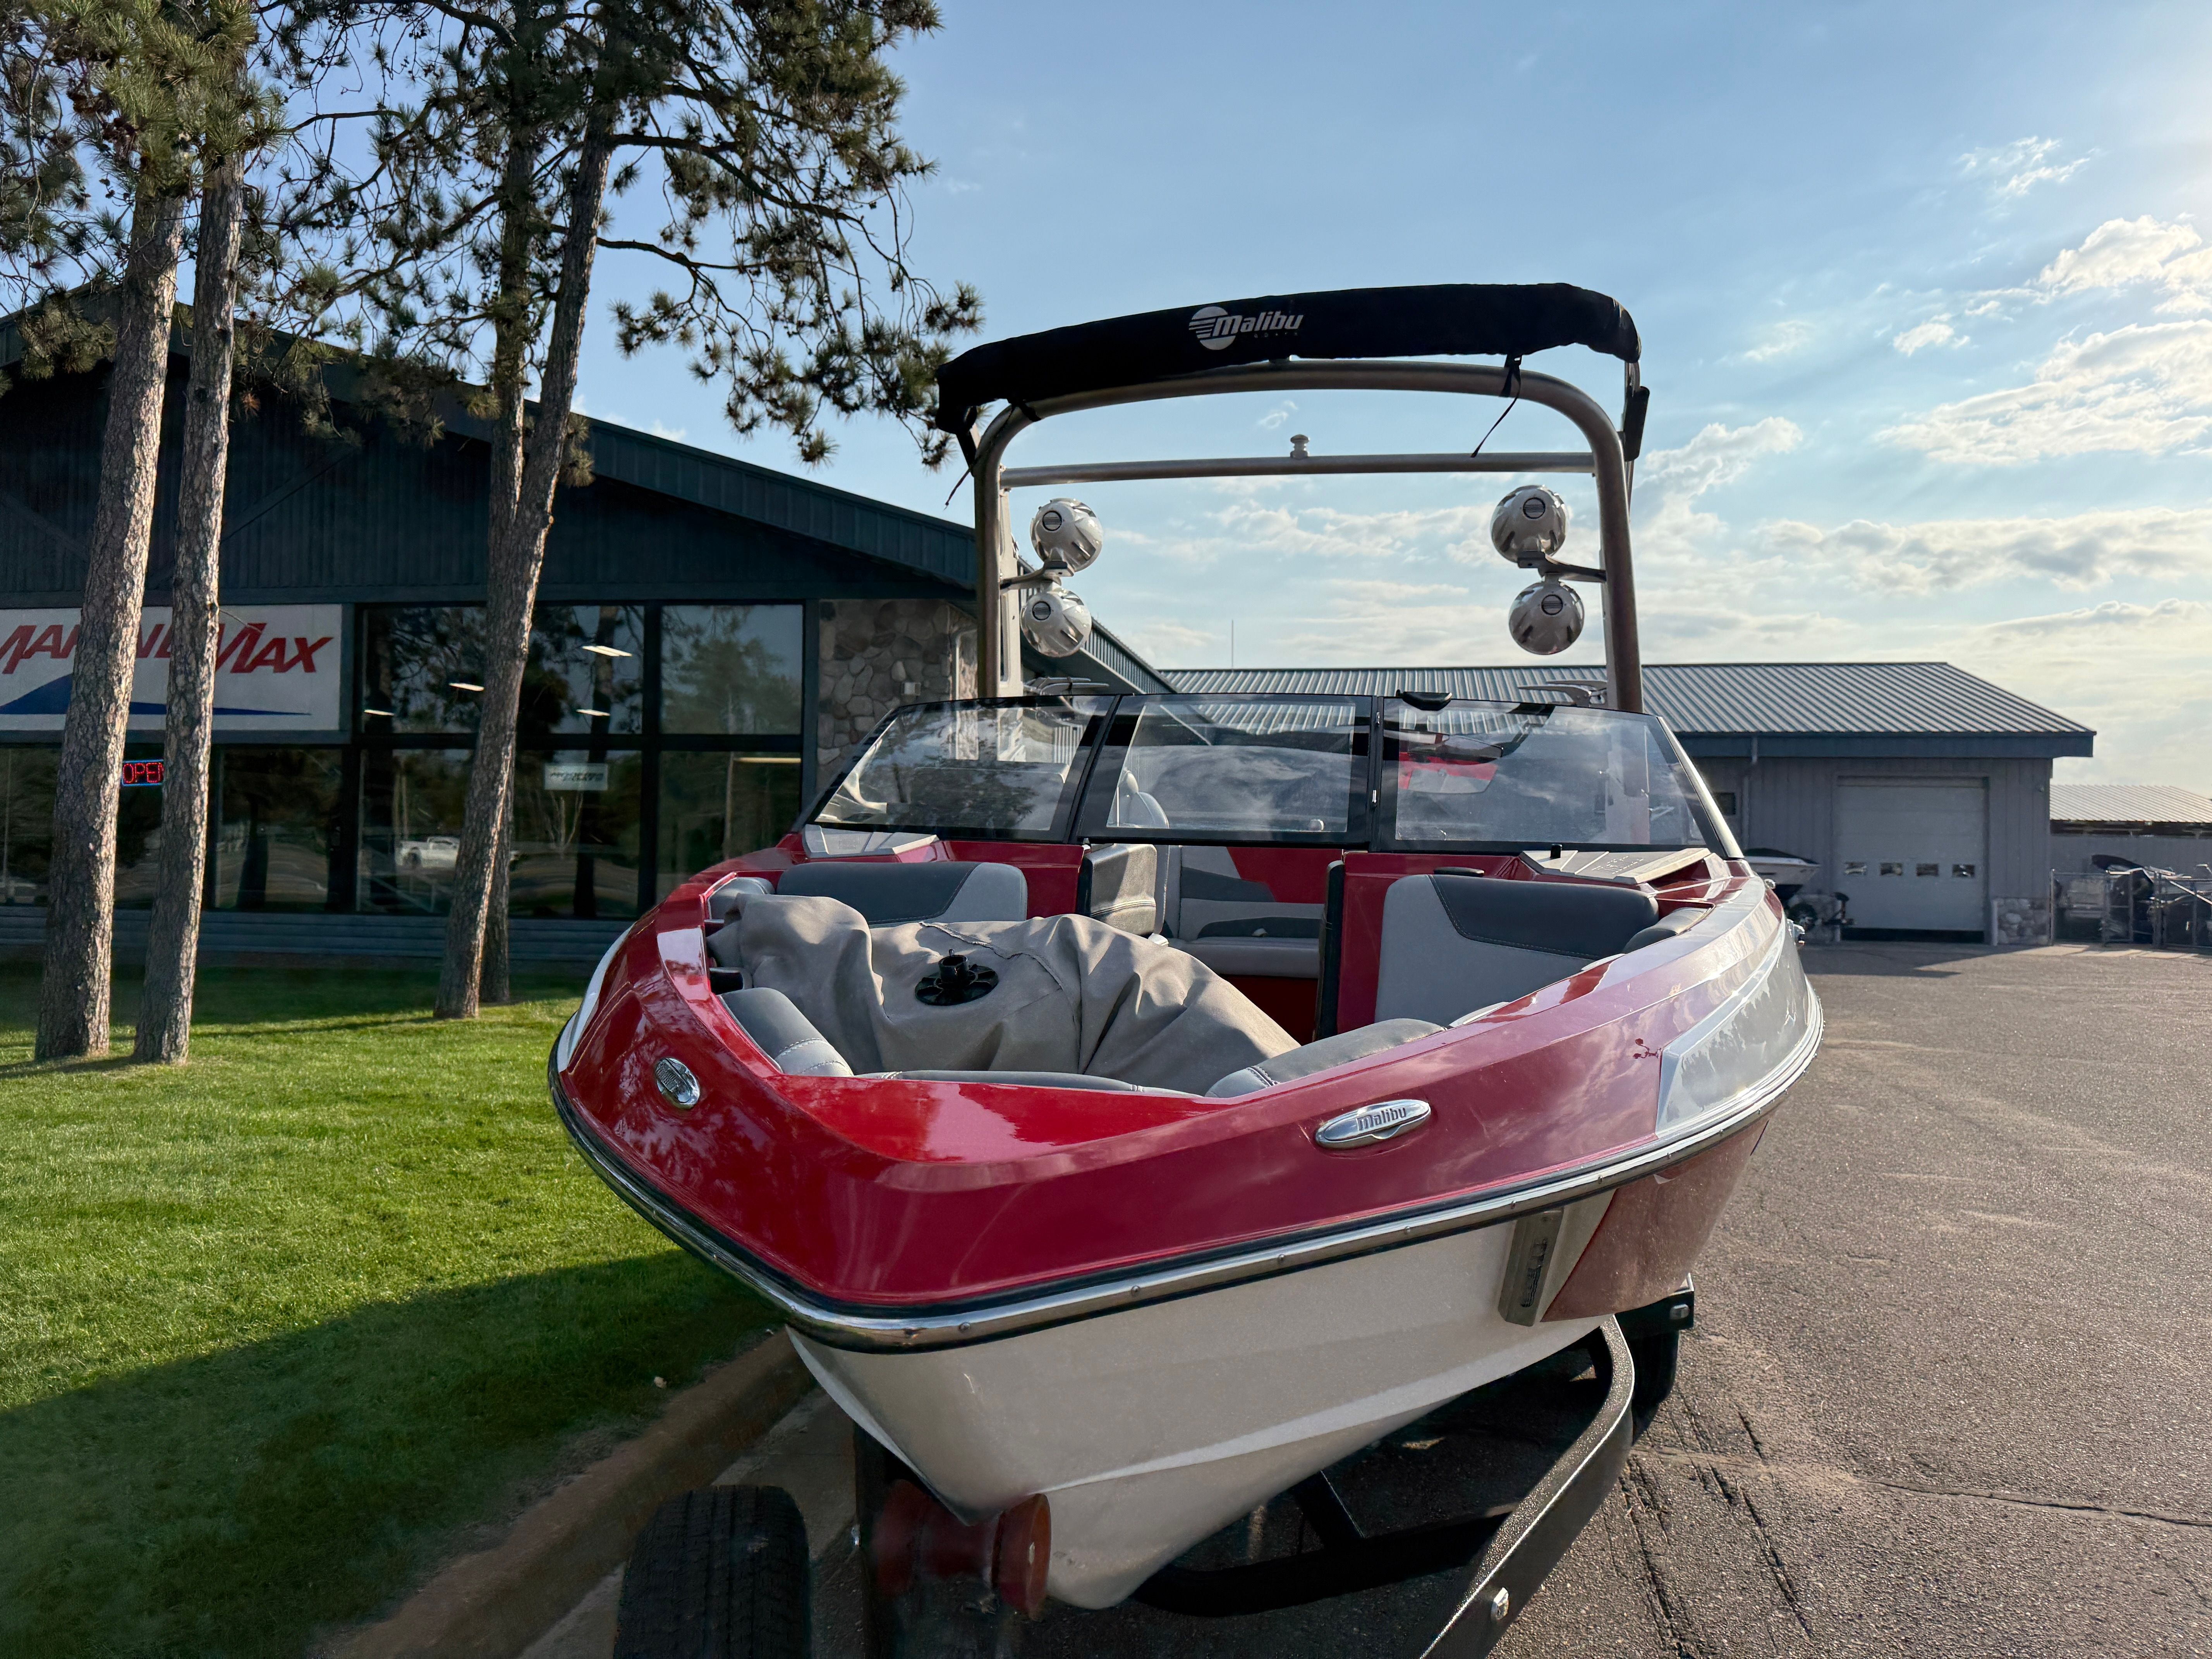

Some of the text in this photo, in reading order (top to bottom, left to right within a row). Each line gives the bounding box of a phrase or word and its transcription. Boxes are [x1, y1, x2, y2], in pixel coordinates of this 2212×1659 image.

[1212, 311, 1304, 337] Malibu
[0, 622, 334, 674] MANMAX
[1356, 1108, 1407, 1131] Malibu
